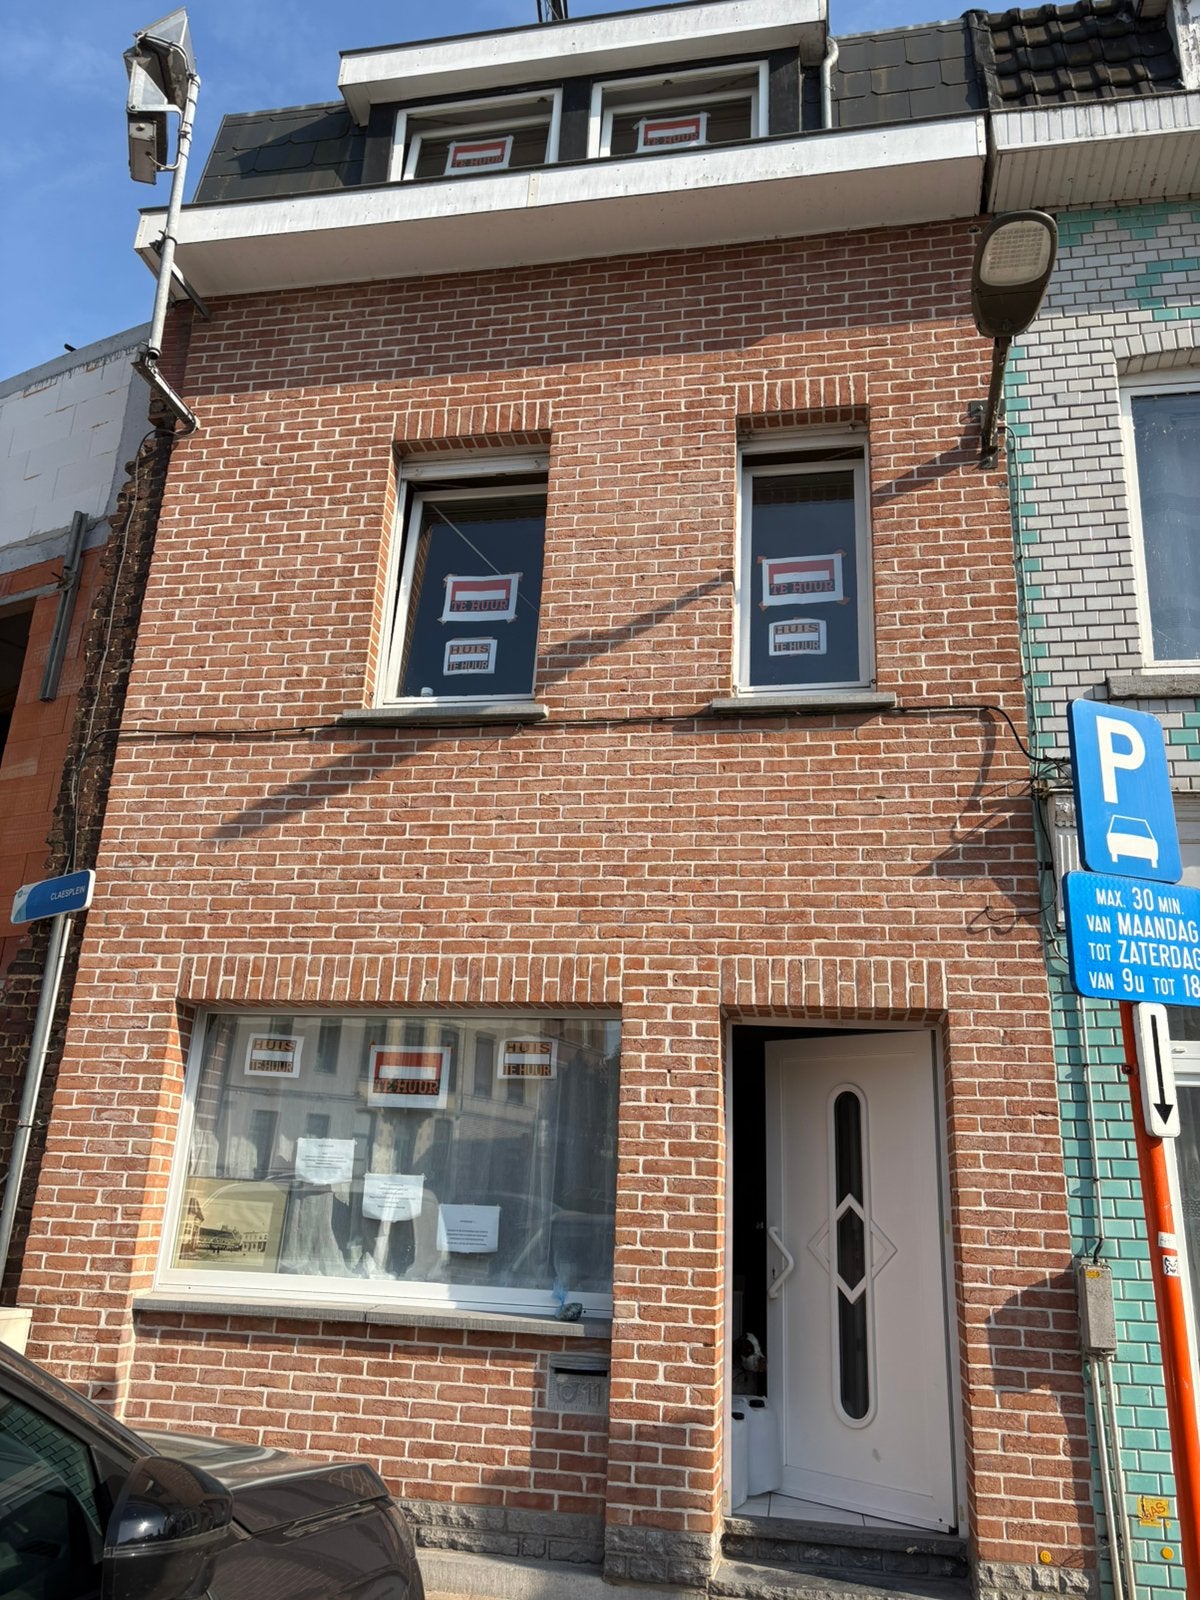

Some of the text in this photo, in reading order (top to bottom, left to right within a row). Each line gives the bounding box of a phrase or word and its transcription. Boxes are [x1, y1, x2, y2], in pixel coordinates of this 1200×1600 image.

[771, 580, 834, 595] TE HUUR
[451, 599, 508, 611] TE HUUR
[449, 644, 490, 655] HUIS
[774, 640, 820, 652] TE HUUR
[448, 659, 489, 671] TE HUUR
[1096, 715, 1146, 804] P
[50, 885, 86, 901] CLAESPLEIN
[1096, 886, 1185, 915] MAX. 30 MIN.
[1086, 911, 1199, 944] VAN MAANDAG
[1088, 942, 1112, 962] TOT
[1089, 970, 1115, 990] VAN
[1122, 967, 1145, 993] 9u
[1152, 977, 1176, 996] TOT
[253, 1039, 297, 1052] HUIS
[504, 1041, 552, 1053] HUIS
[249, 1060, 293, 1073] TE HUUR
[503, 1064, 552, 1076] TE HUUR
[374, 1079, 440, 1094] TE HUUR
